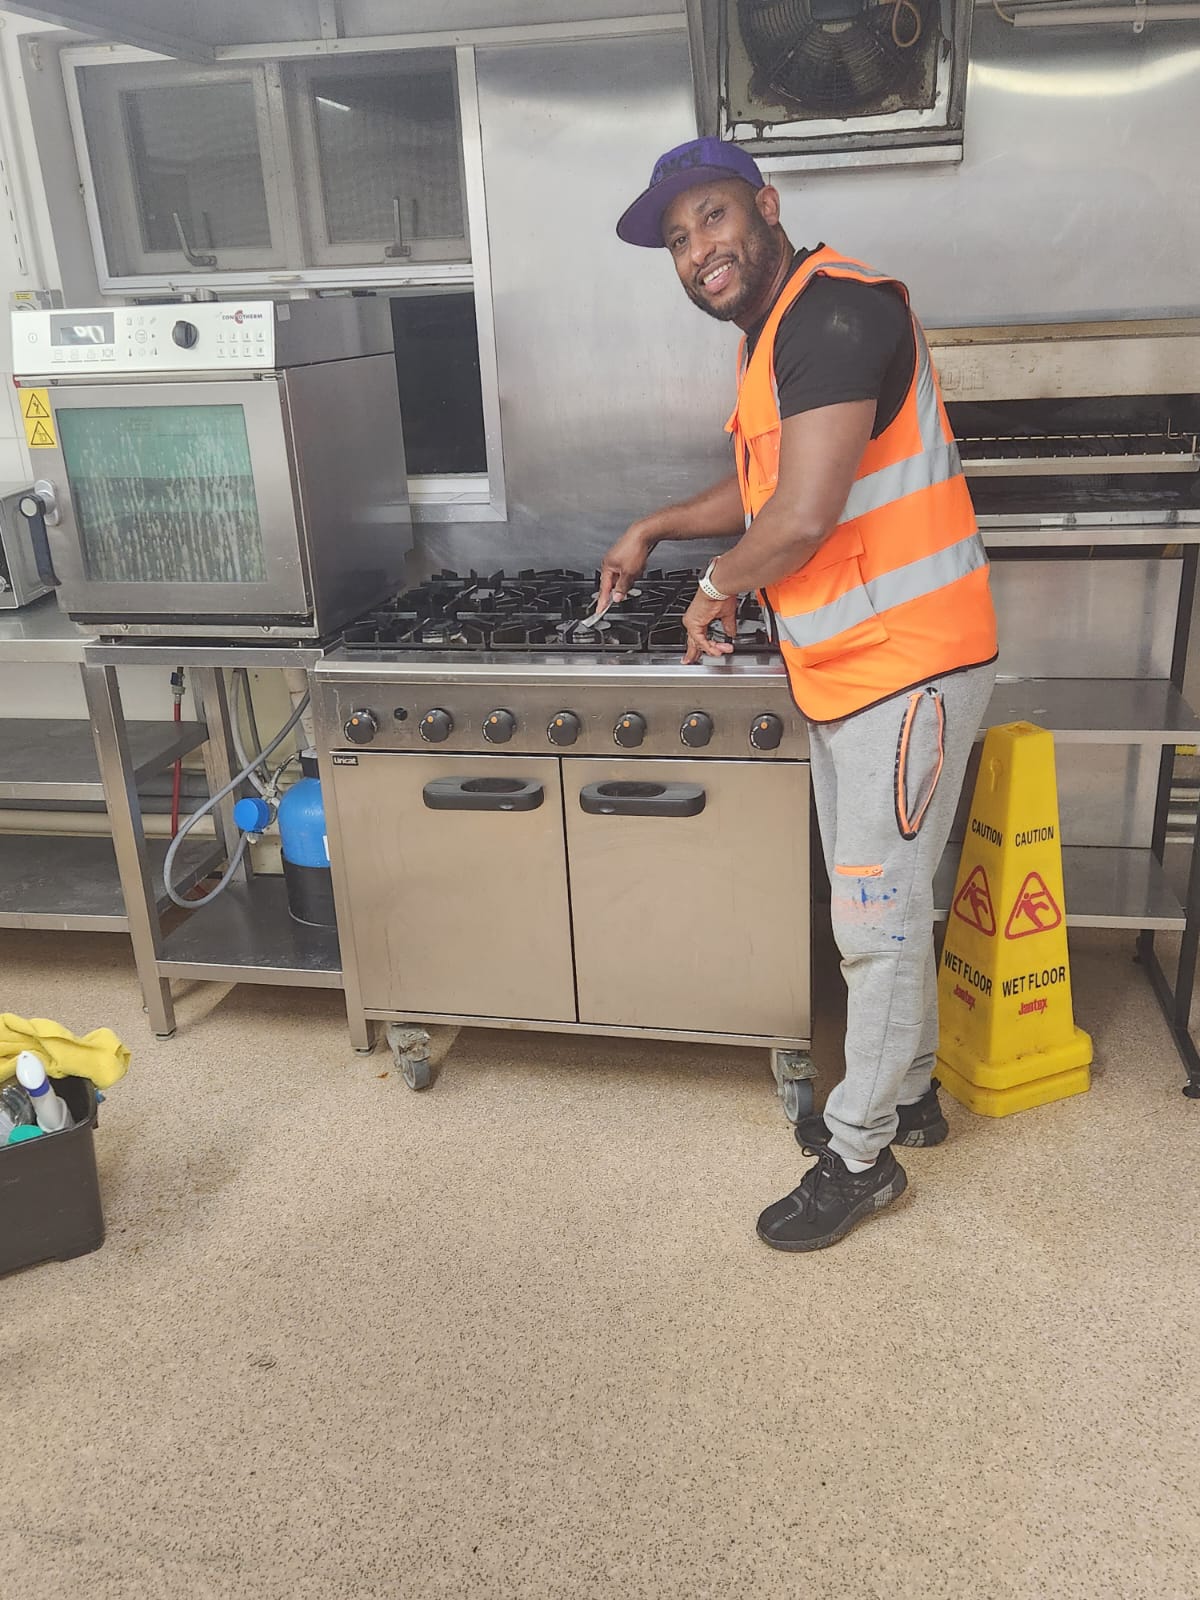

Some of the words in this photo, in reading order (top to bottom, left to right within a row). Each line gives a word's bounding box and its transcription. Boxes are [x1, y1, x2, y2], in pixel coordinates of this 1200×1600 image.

[971, 818, 1003, 847] CAUTION
[1015, 826, 1054, 847] CAUTION
[944, 949, 963, 976] WET
[963, 962, 993, 997] FLOOR
[1002, 976, 1026, 998] WET
[1028, 966, 1066, 990] FLOOR
[1018, 998, 1048, 1016] Jantex
